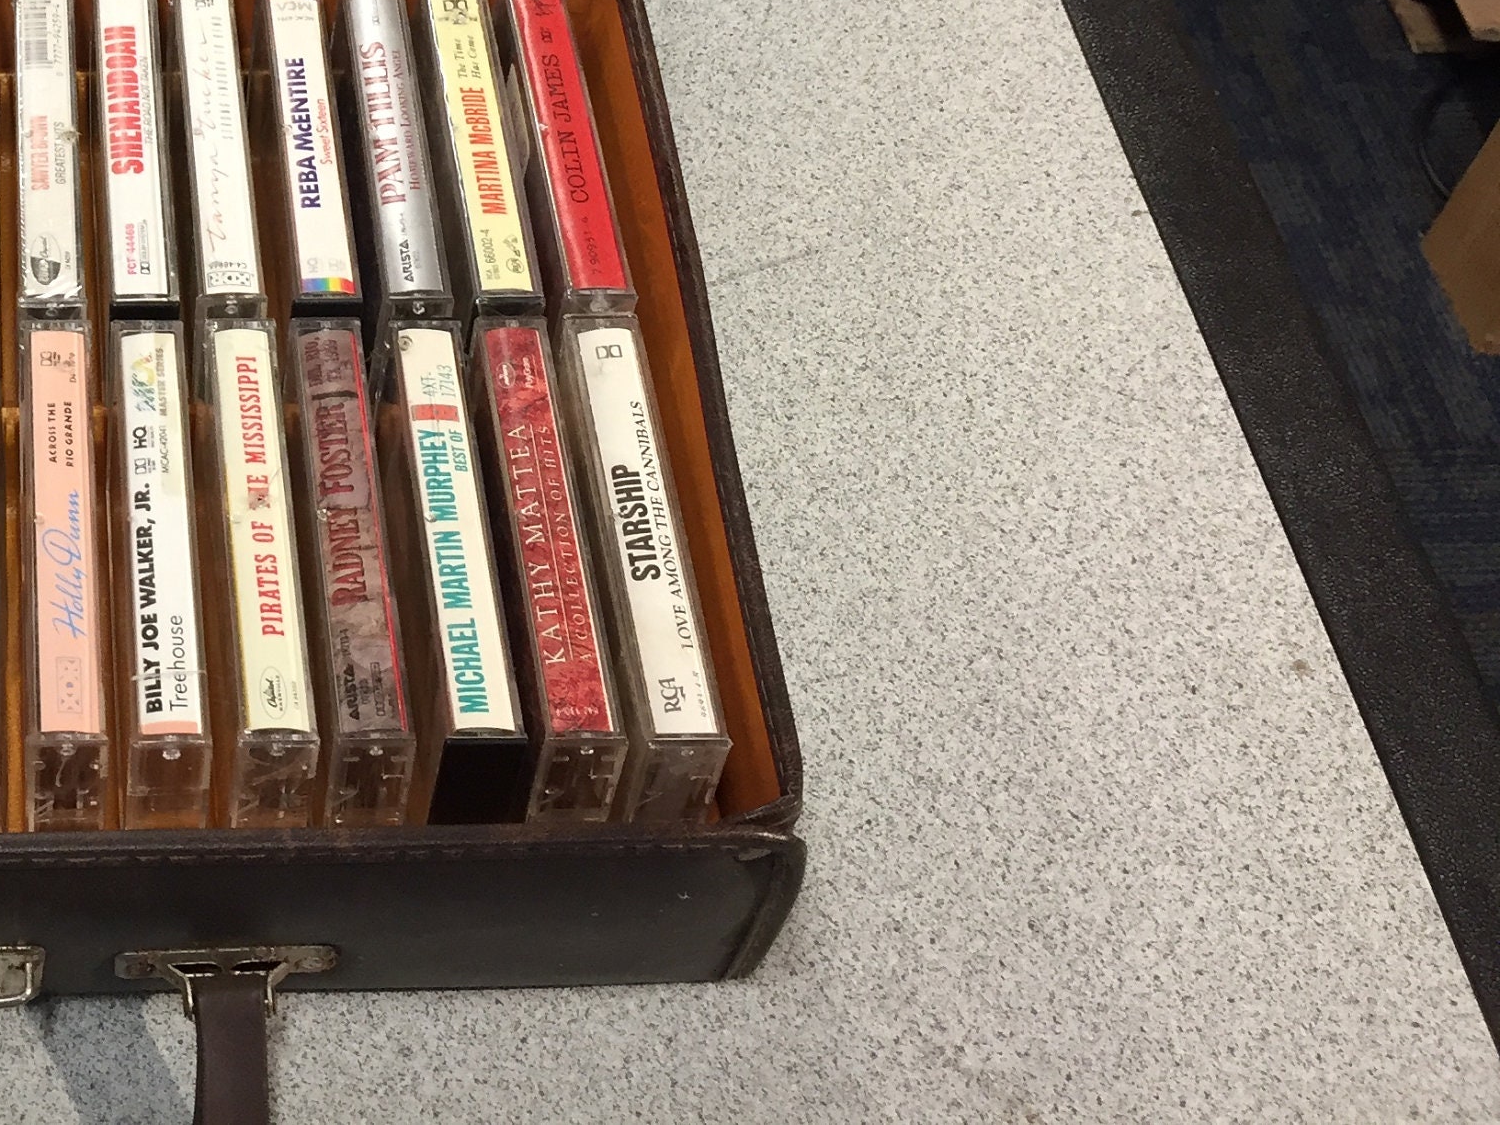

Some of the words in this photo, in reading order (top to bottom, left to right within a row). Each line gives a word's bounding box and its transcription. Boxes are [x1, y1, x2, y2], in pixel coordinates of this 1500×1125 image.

[276, 1, 312, 11] MCA
[454, 39, 466, 59] Time
[467, 36, 479, 59] Come
[139, 56, 150, 83] TAKEN
[360, 41, 396, 130] TILLIS
[457, 63, 469, 78] The
[542, 54, 571, 123] JAMES
[104, 26, 145, 175] SHENANDOAH
[141, 86, 151, 102] NOT
[285, 58, 314, 151] McENTIRE
[143, 104, 152, 126] ROAD
[316, 99, 328, 133] Sixteen
[460, 87, 494, 145] McBRIDE
[144, 128, 153, 145] THE
[317, 135, 332, 164] Sweet
[30, 152, 50, 190] SAWYER
[54, 144, 67, 184] GREATEST
[296, 155, 321, 208] REBA
[373, 137, 406, 206] PAM
[472, 151, 508, 215] MARTINA
[557, 131, 590, 203] COLIN
[127, 258, 137, 275] FCT
[399, 239, 415, 282] ARISTA
[480, 229, 497, 263] 66002-4
[155, 347, 165, 377] SERIES
[309, 364, 323, 386] DEL
[437, 364, 457, 397] 17143
[157, 380, 168, 416] MASTER
[420, 371, 438, 397] 4XT-
[47, 403, 57, 422] THE
[64, 401, 75, 445] GRANDE
[235, 356, 267, 464] MISSISSIPPI
[49, 426, 58, 463] ACROSS
[314, 402, 354, 496] FOSTER
[448, 429, 465, 442] OF
[539, 426, 557, 468] HITS
[630, 401, 660, 492] CANNIBALS
[65, 448, 76, 467] RIO
[417, 429, 459, 521] MURPHEY
[450, 445, 469, 472] BEST
[134, 483, 152, 511] JR.
[508, 425, 547, 545] MATTEA
[546, 478, 562, 501] OF
[42, 489, 83, 566] Dunn
[251, 521, 275, 543] OF
[611, 464, 661, 582] STARSHIP
[650, 496, 669, 530] THE
[136, 518, 156, 609] WALKER,
[326, 507, 370, 606] RADNEY
[432, 530, 473, 609] MARTIN
[554, 513, 588, 640] COLLECTION
[659, 534, 684, 600] AMONG
[50, 566, 88, 639] Holly
[254, 554, 285, 636] PIRATES
[528, 562, 567, 665] KATHY
[141, 613, 159, 650] JOE
[672, 604, 694, 650] LOVE
[166, 615, 188, 711] Treehouse
[447, 618, 490, 713] MICHAEL
[577, 653, 591, 661] A
[142, 658, 163, 713] BILLY
[264, 677, 278, 708] Capitol
[343, 663, 360, 721] ARISTA
[659, 676, 687, 713] RCA
